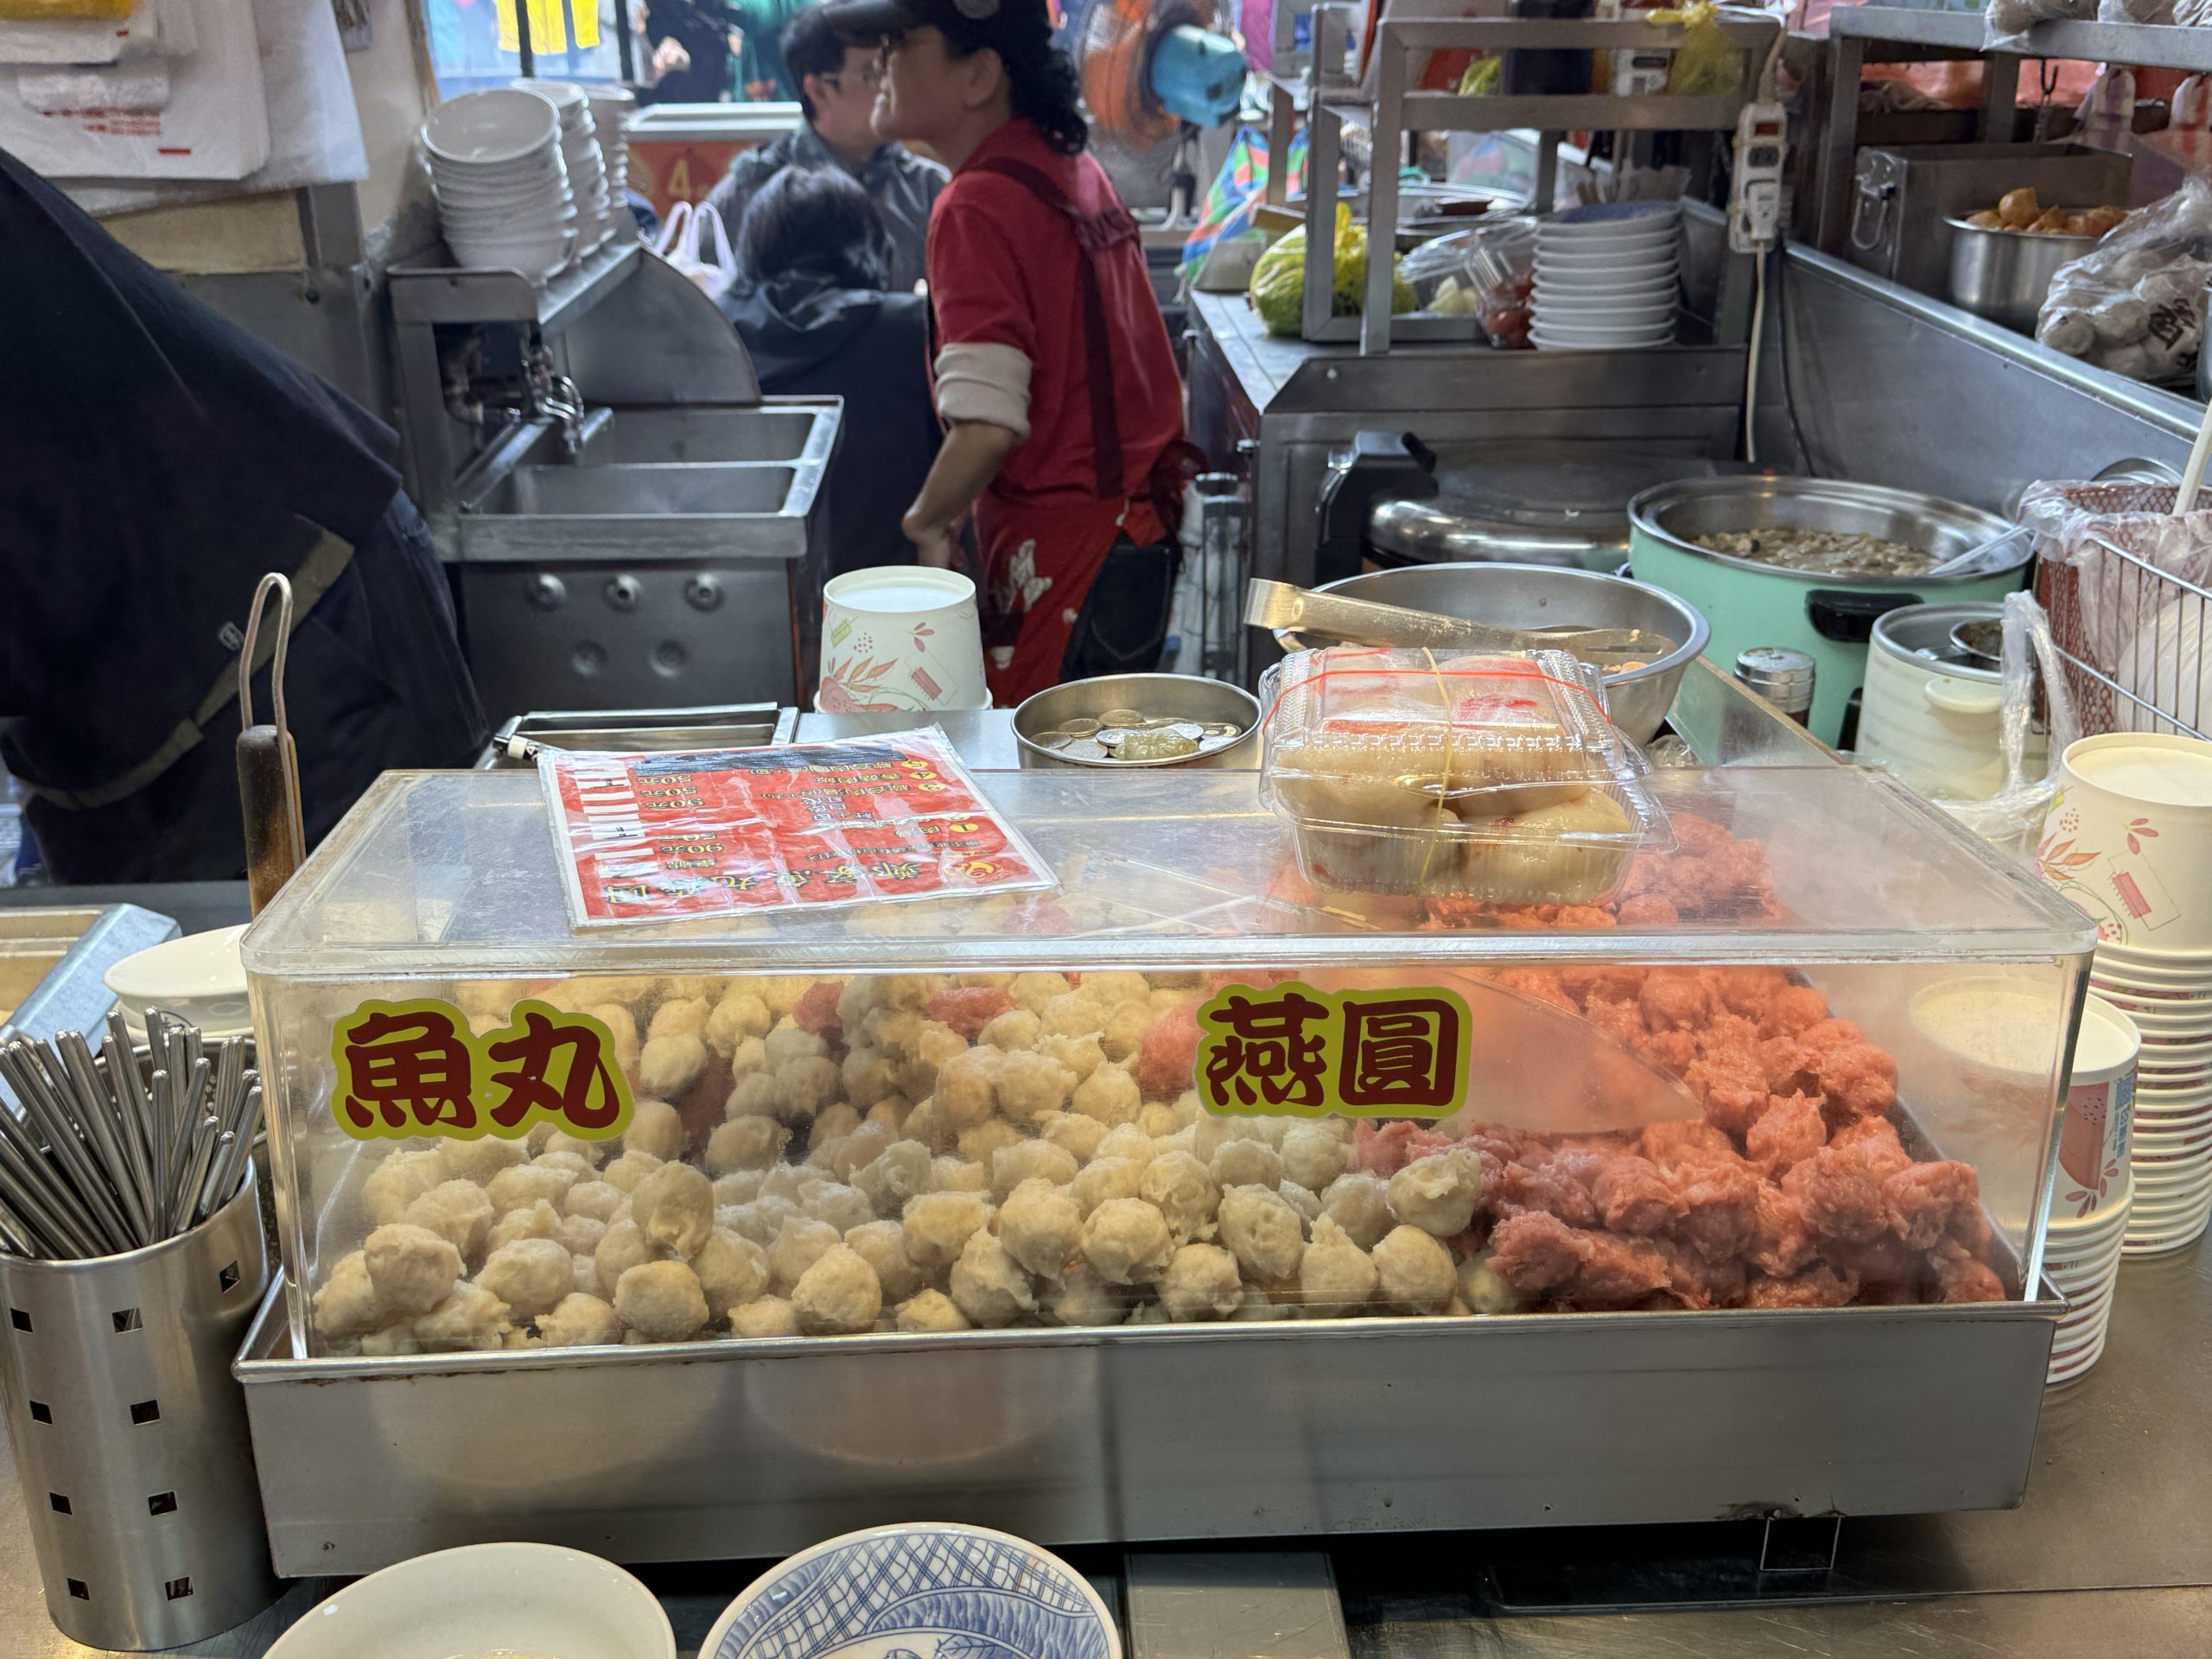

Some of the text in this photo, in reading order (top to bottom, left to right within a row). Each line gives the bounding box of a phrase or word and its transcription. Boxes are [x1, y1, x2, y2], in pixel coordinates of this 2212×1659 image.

[637, 775, 691, 785] 50元
[641, 786, 698, 797] 50元
[646, 798, 704, 809] 90元
[659, 843, 723, 854] 90元
[1206, 993, 1459, 1107] 燕圓
[345, 1011, 620, 1128] 魚丸
